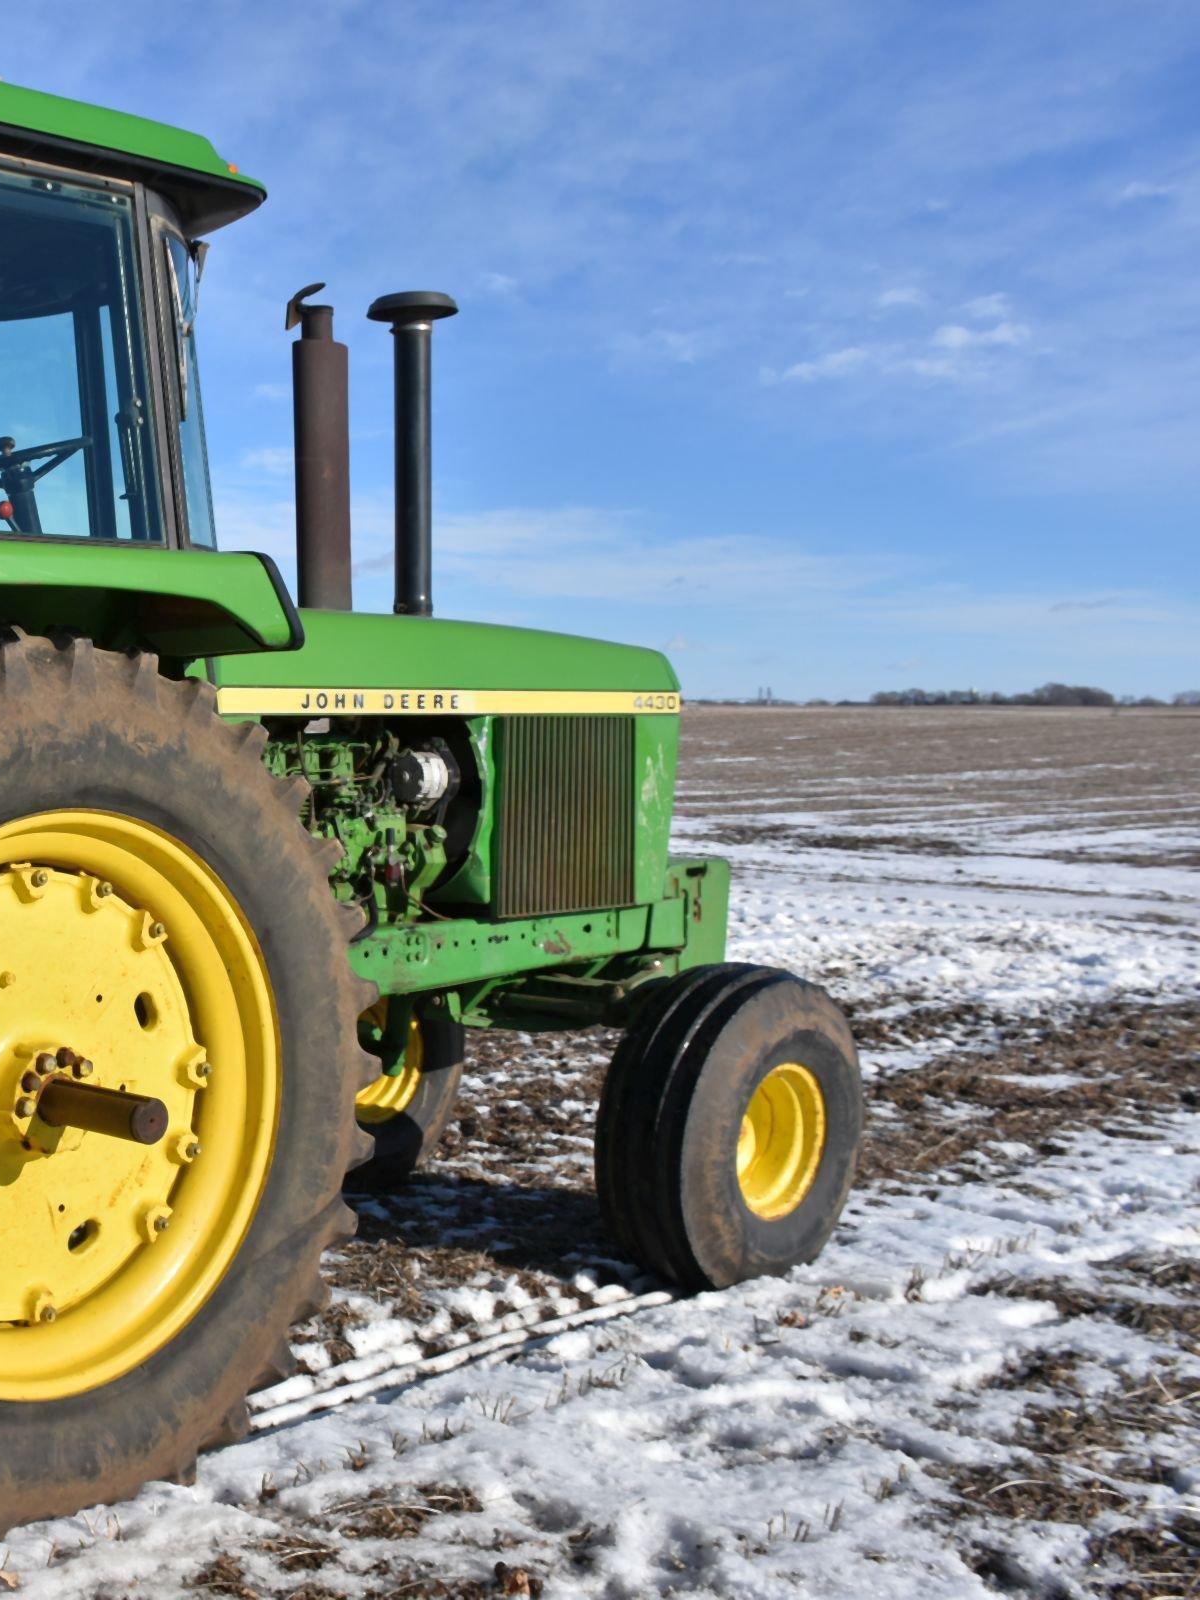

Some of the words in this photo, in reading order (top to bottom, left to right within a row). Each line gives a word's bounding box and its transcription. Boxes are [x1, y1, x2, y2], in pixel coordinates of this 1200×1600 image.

[301, 693, 365, 709] JOHN
[383, 694, 459, 709] DEERE
[634, 695, 677, 710] 4430
